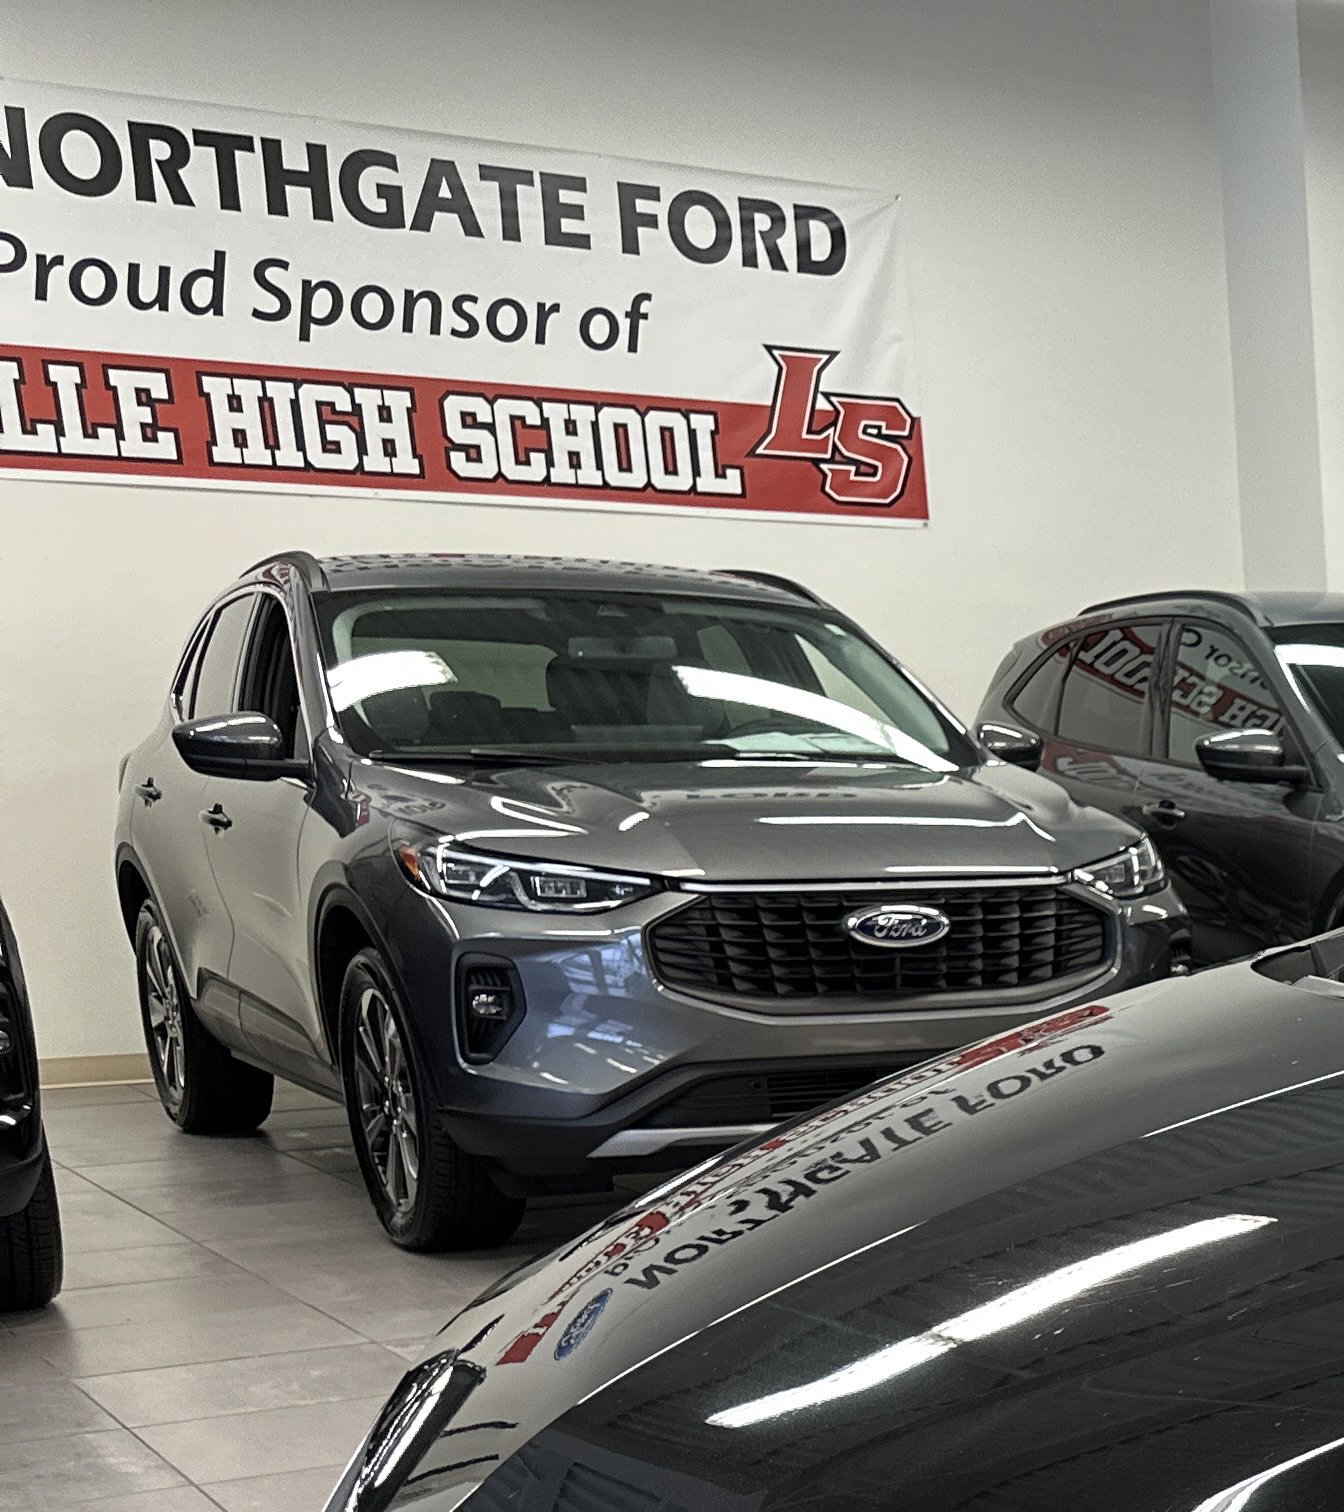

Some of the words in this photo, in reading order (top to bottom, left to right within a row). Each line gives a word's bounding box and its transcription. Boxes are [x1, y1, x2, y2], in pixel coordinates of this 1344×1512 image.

[616, 181, 848, 276] FORD
[251, 256, 561, 346] Sponsor
[579, 292, 653, 355] of
[197, 372, 425, 479] HIGH
[437, 389, 747, 498] SCHOOL
[872, 913, 928, 938] Ford
